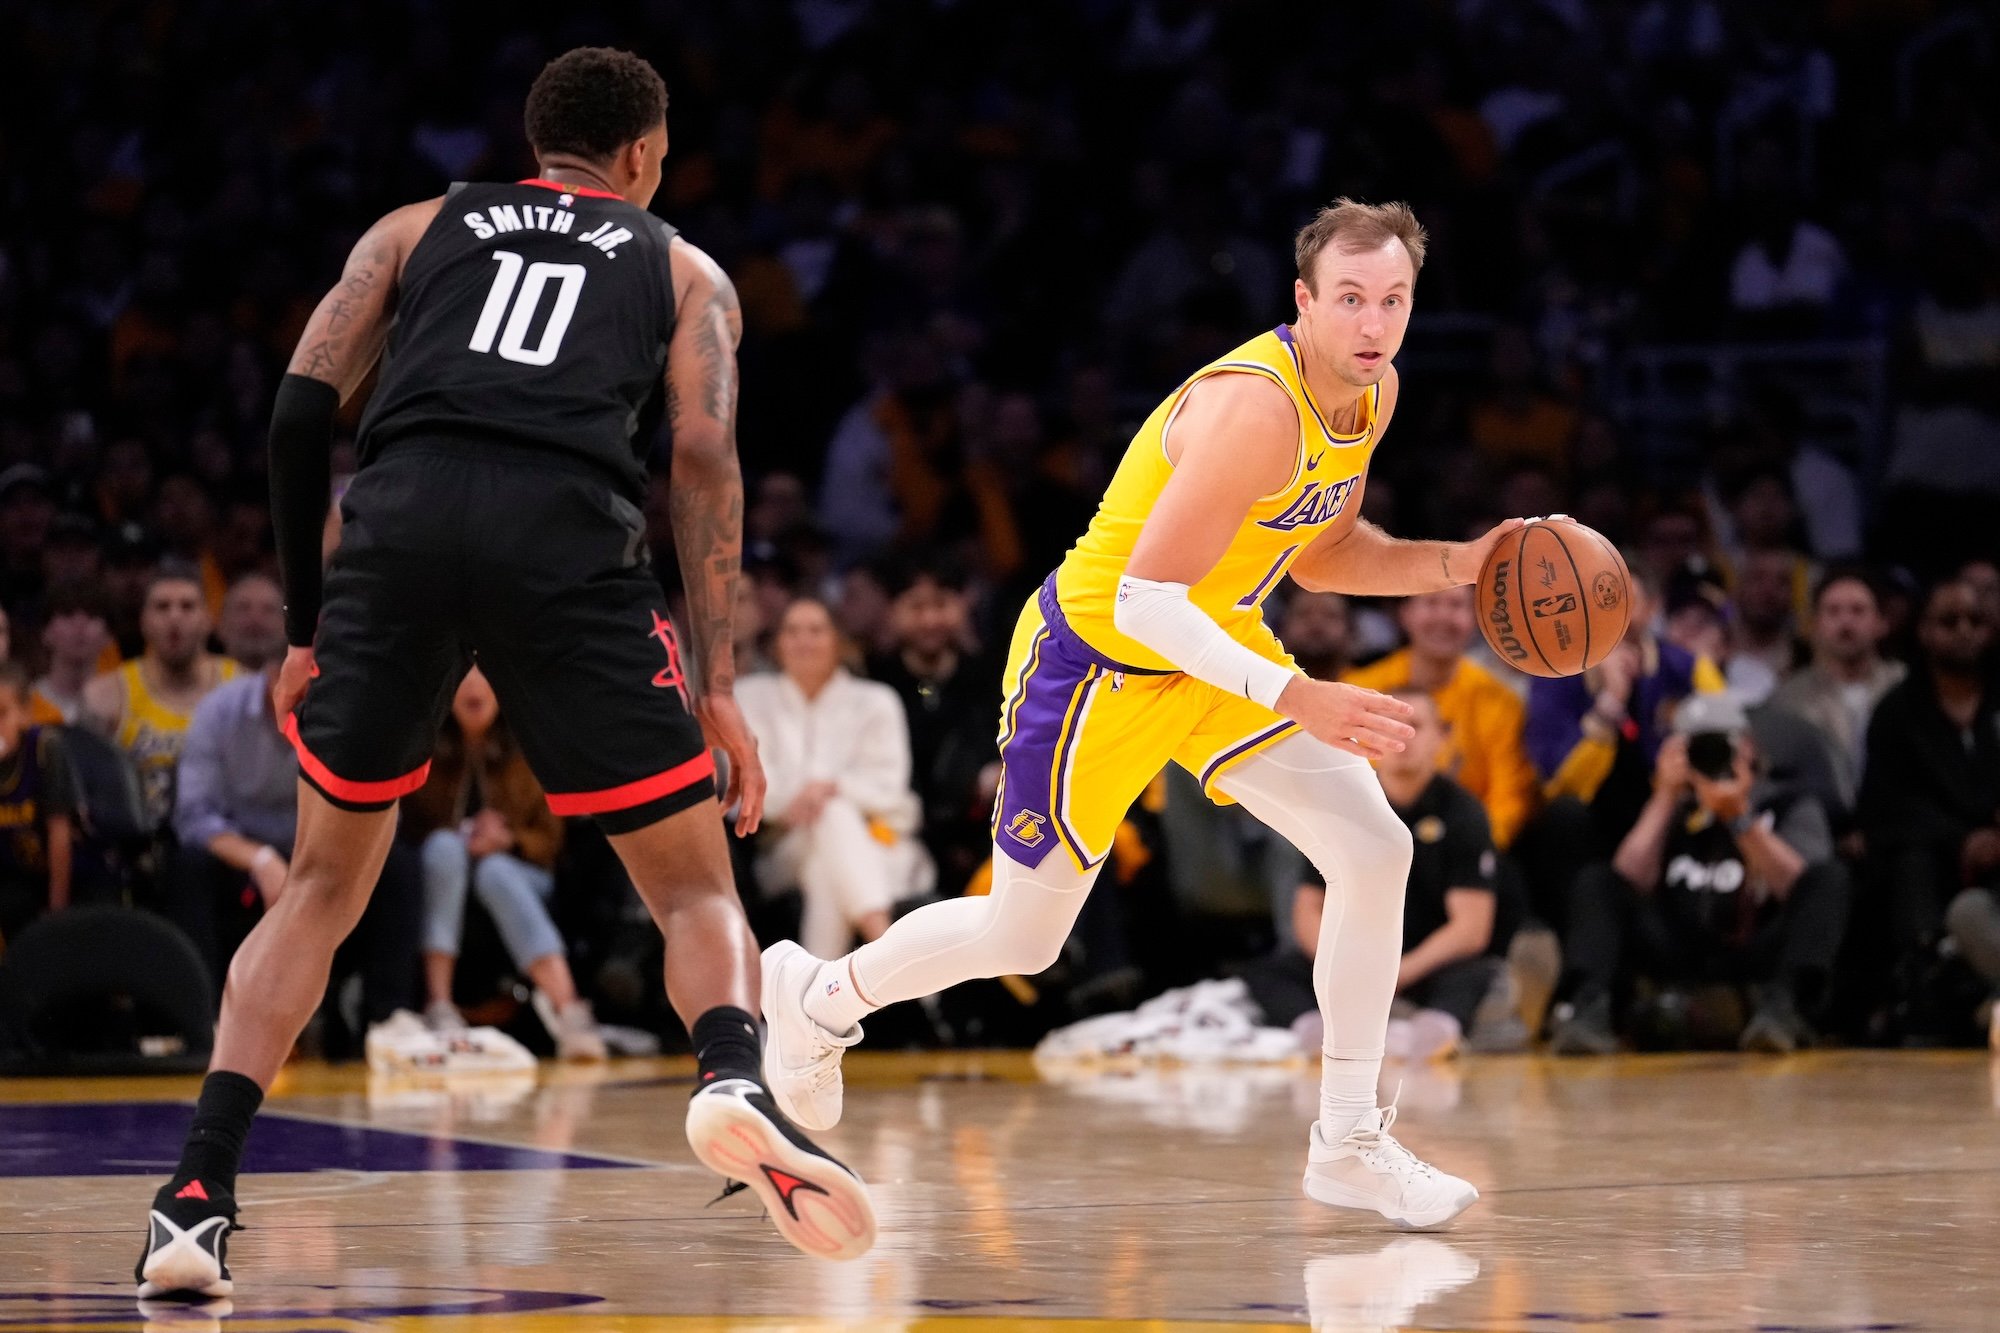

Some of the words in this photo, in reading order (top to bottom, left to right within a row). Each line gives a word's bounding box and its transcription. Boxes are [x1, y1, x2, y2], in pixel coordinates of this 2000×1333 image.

[463, 204, 576, 240] SMITH
[577, 221, 634, 260] JR.
[468, 250, 587, 367] 10
[1489, 559, 1528, 661] Wilson
